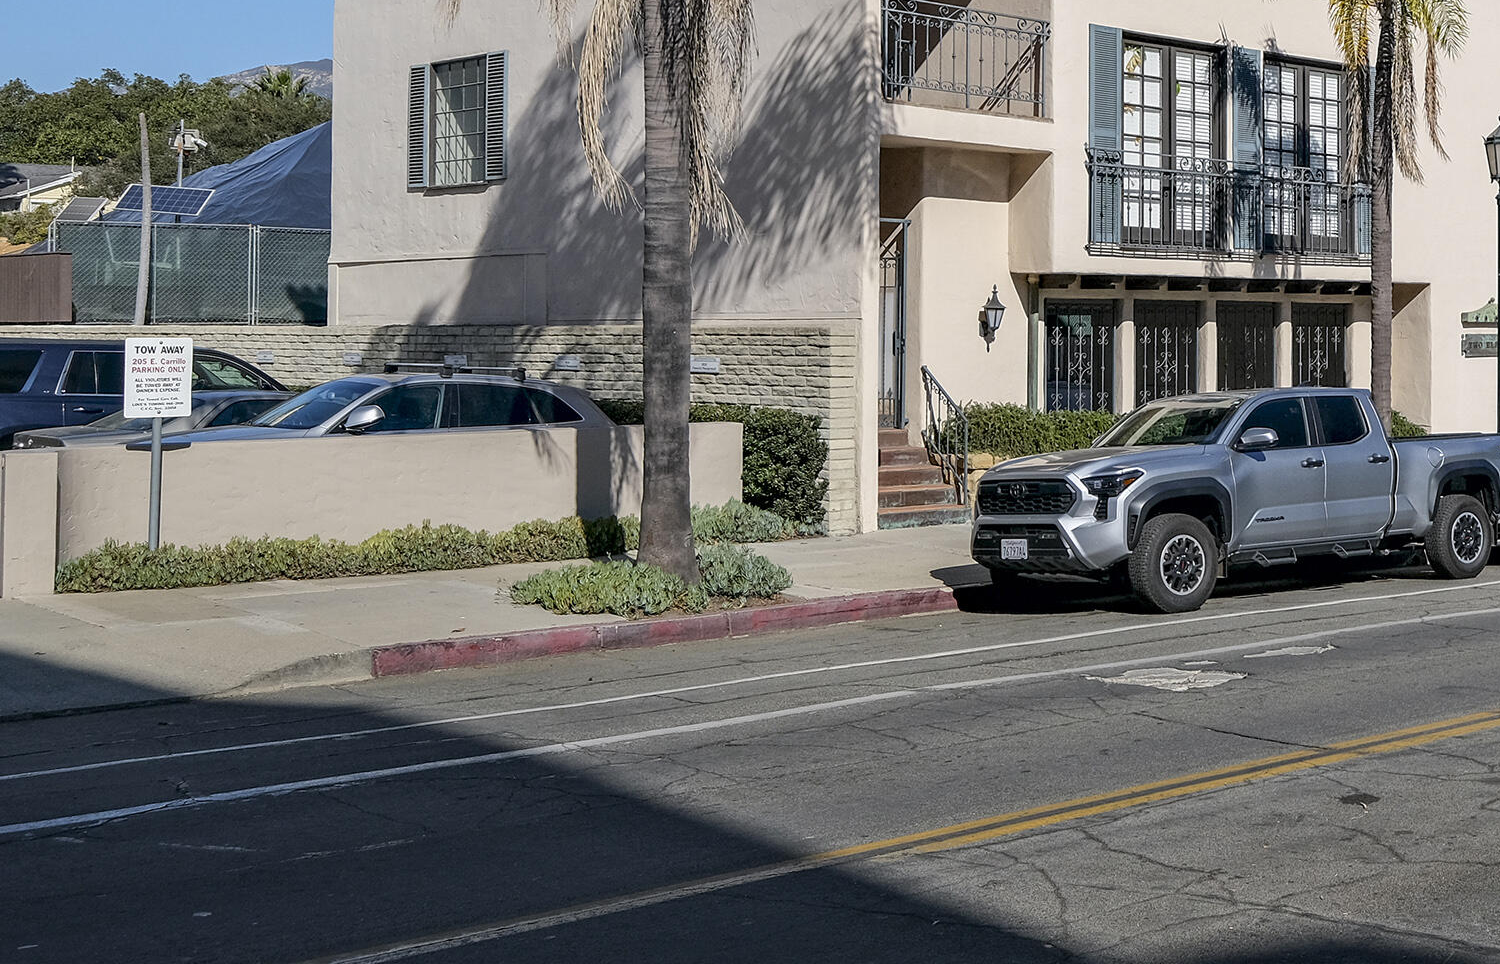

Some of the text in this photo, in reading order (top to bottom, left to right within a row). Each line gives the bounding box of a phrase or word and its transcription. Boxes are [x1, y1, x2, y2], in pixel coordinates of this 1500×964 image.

[134, 345, 185, 354] TOW AWAY
[160, 357, 187, 365] Carrillo
[131, 366, 166, 374] PARKING
